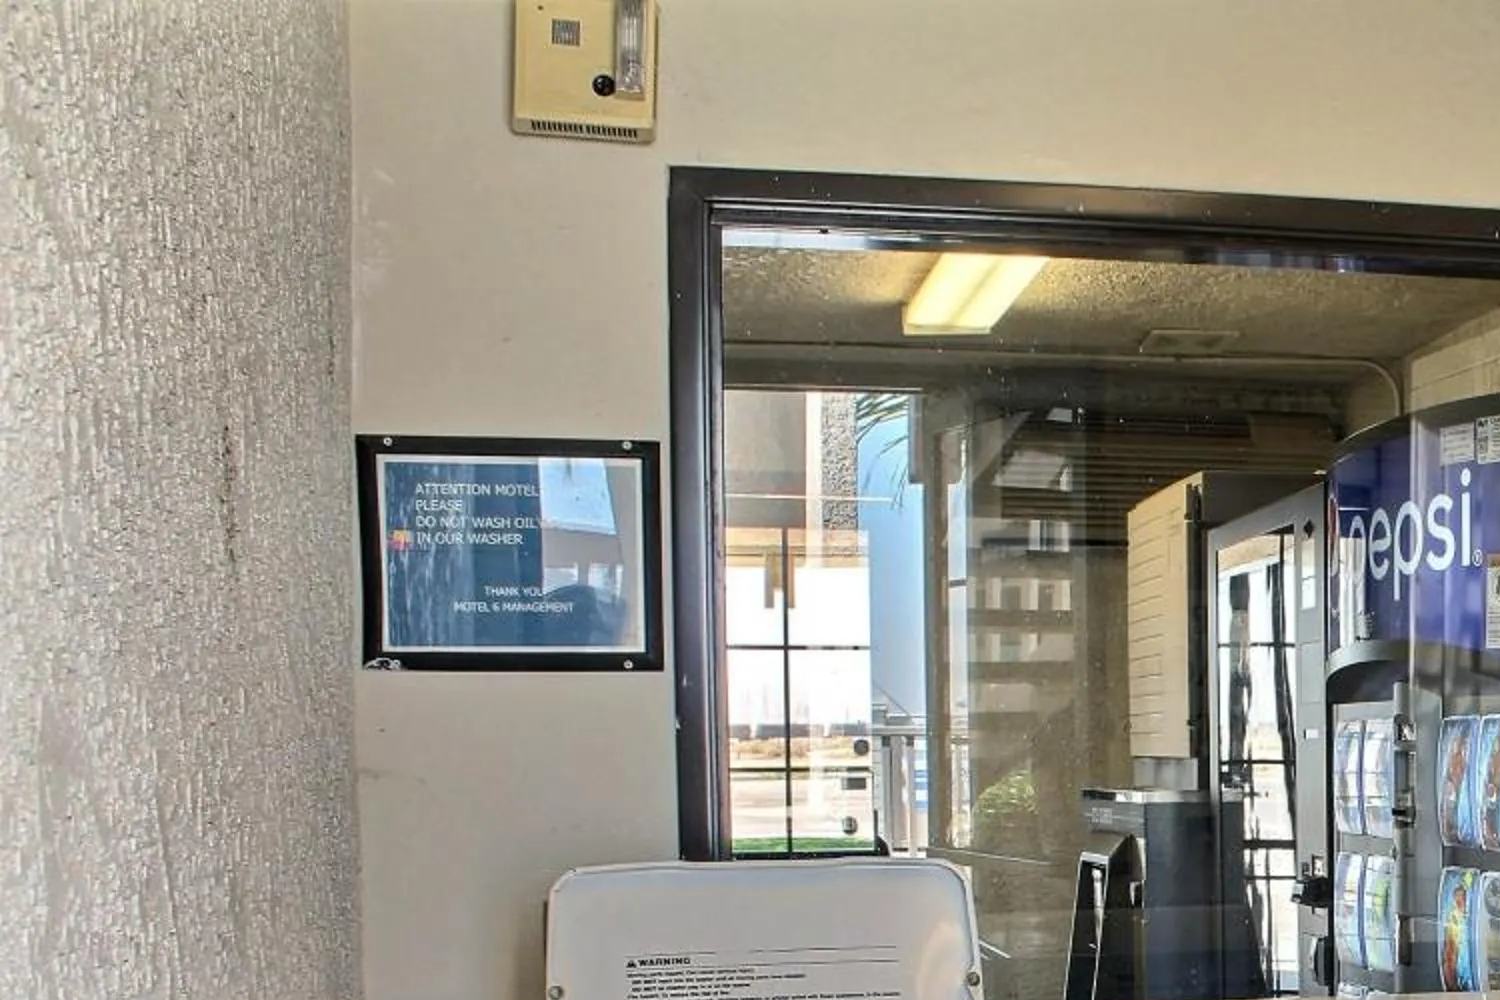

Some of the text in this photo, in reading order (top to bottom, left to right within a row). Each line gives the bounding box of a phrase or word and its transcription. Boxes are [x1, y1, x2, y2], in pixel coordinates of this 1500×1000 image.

[415, 483, 491, 496] ATTENTION
[415, 499, 463, 512] PLEASE
[415, 515, 436, 528] DO
[440, 516, 466, 528] NOT
[471, 517, 511, 529] WASH
[416, 532, 524, 545] IN OUR WASHER
[484, 585, 520, 596] THANK
[454, 601, 490, 613] MOTEL
[502, 601, 574, 614] MANAGEMENT
[637, 957, 691, 967] WARNING
